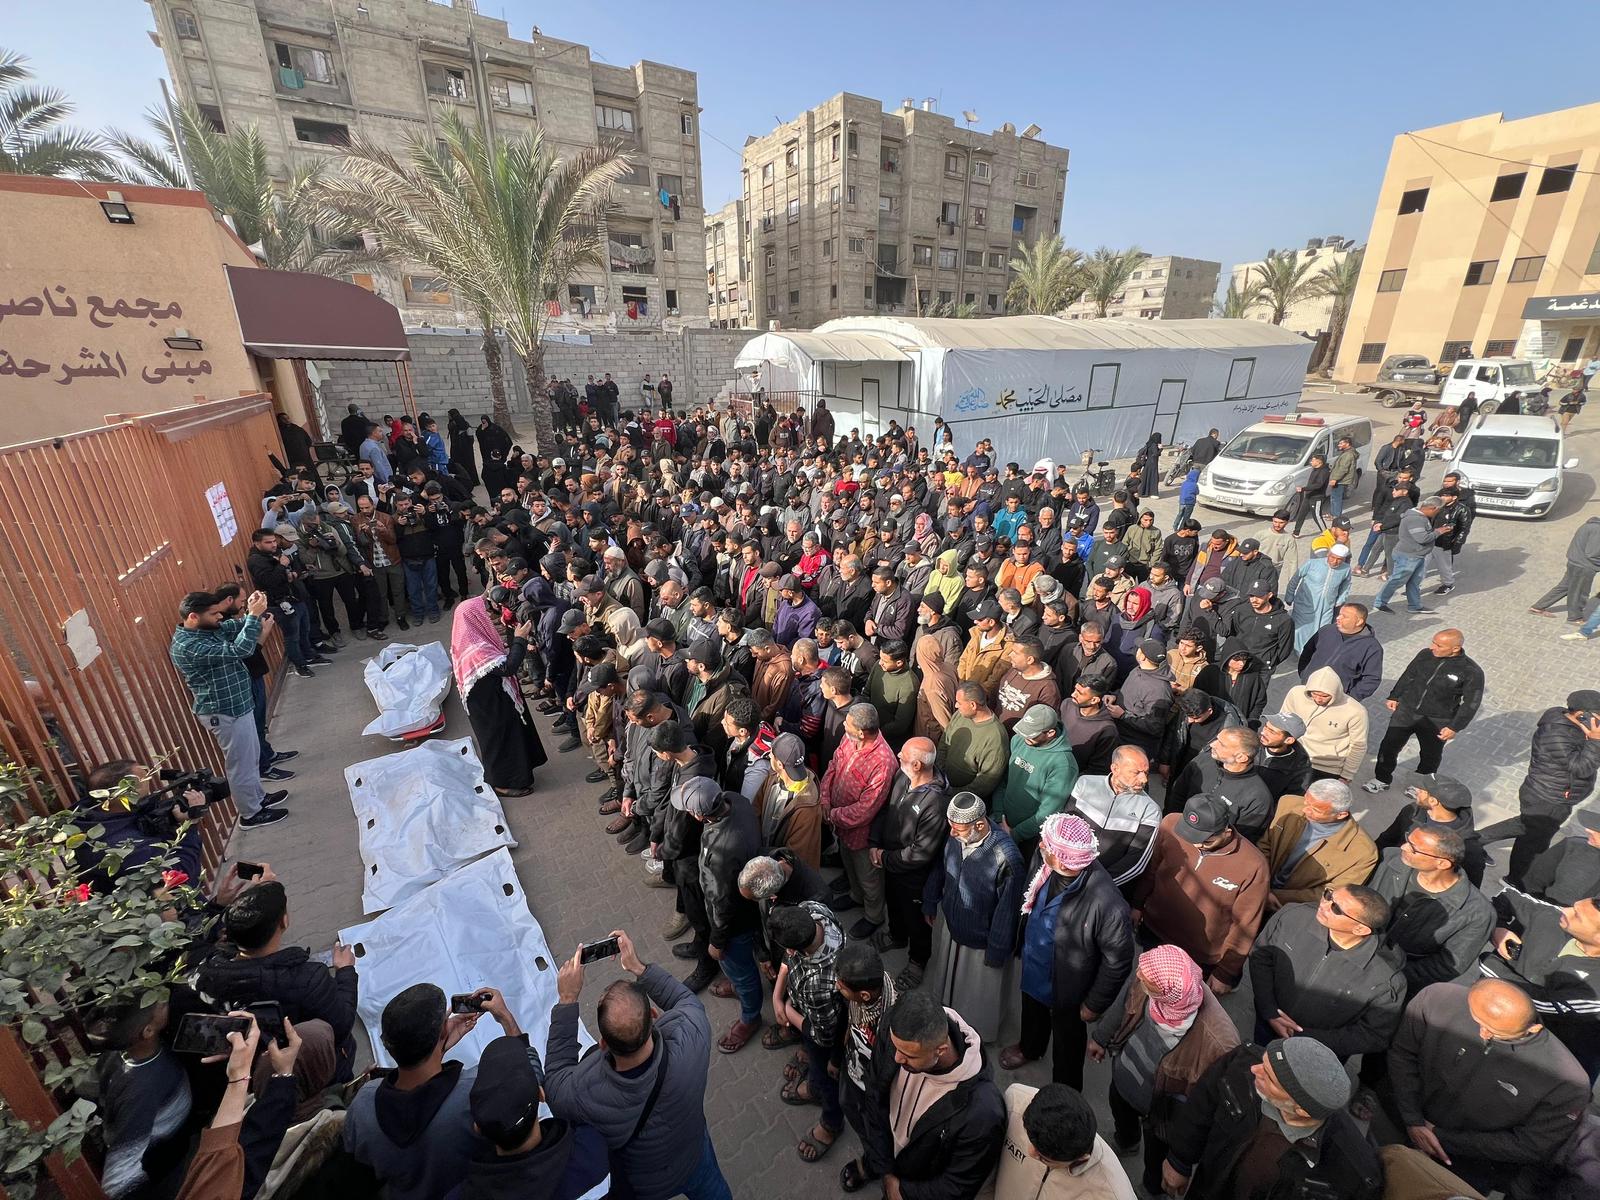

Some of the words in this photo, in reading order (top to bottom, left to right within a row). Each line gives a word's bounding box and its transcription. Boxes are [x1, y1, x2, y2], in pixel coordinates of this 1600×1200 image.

[87, 295, 183, 328] مجمع
[0, 346, 127, 385] المشرحة
[141, 350, 212, 384] مبنى
